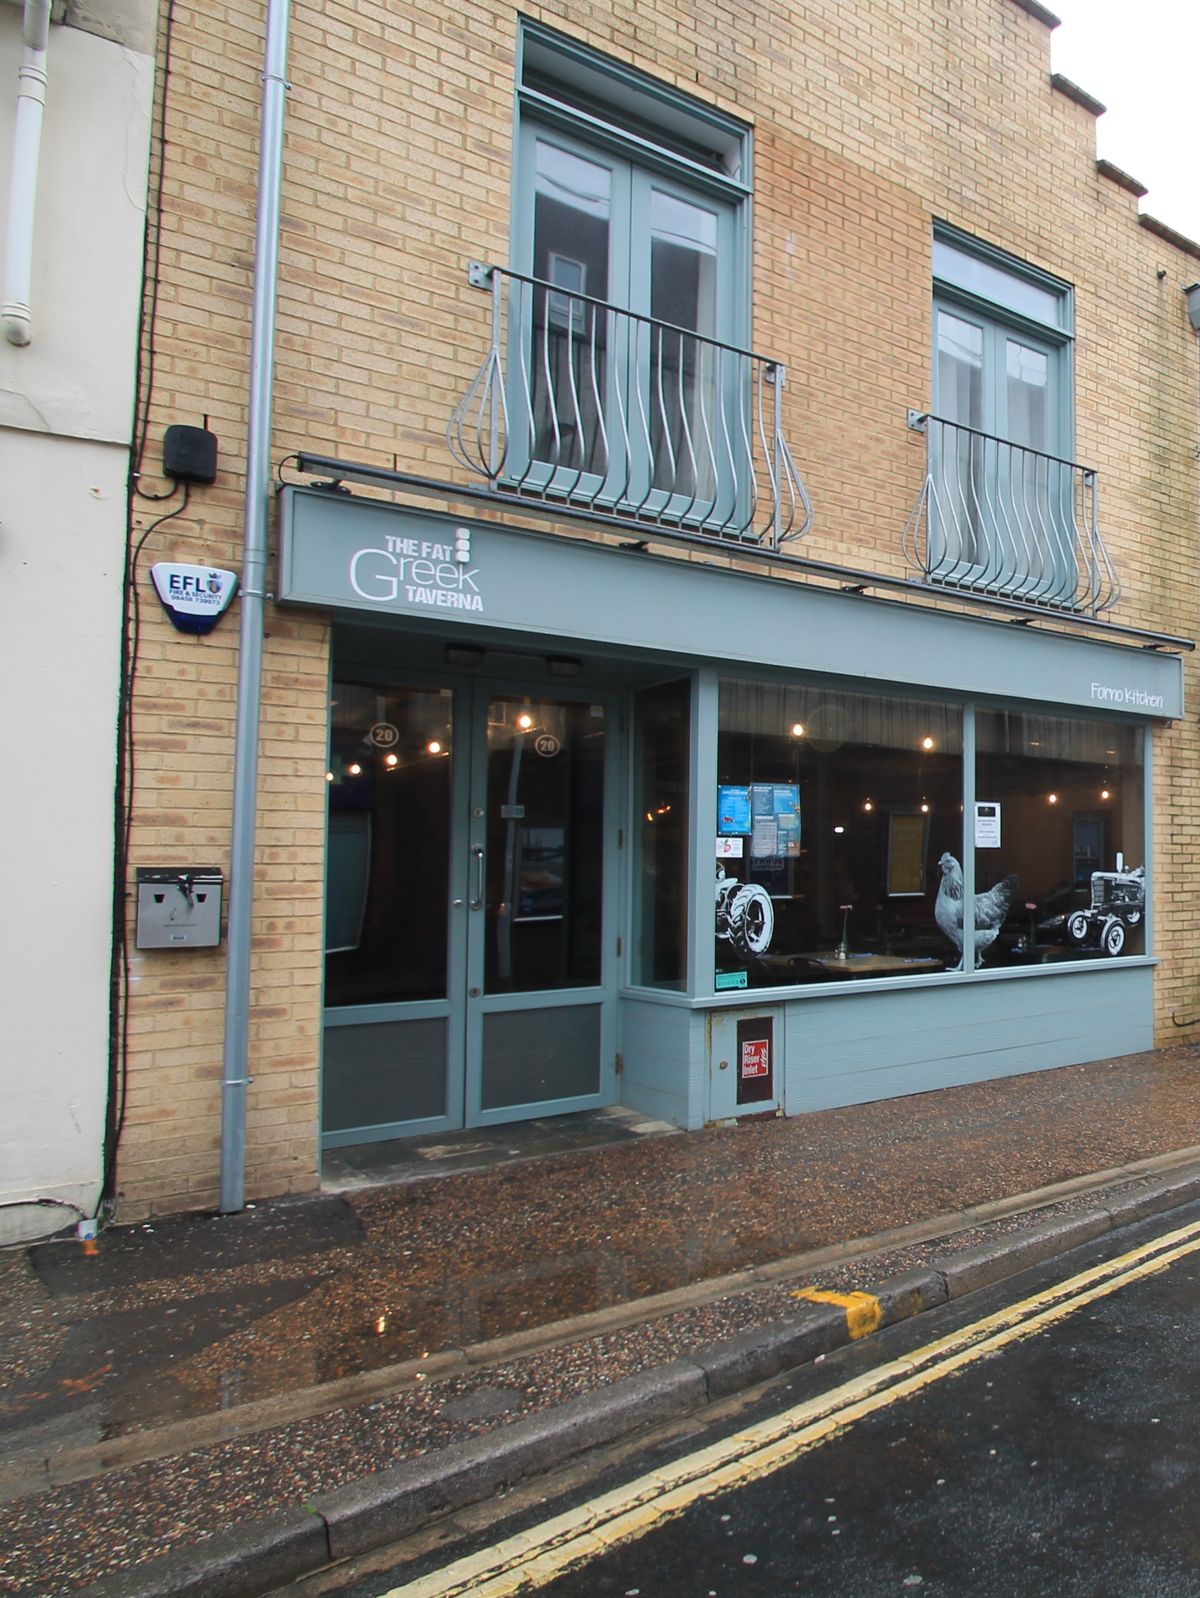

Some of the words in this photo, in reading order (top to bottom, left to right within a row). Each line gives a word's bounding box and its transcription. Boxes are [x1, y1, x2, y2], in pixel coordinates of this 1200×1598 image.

[385, 535, 418, 556] THE
[421, 541, 453, 561] FAT
[350, 548, 480, 601] Greek
[169, 574, 206, 593] EFL
[405, 585, 484, 612] TAVERNA
[1125, 687, 1164, 708] Kitchen
[375, 729, 393, 742] 20
[540, 740, 555, 752] 20
[744, 1044, 755, 1056] Dry
[744, 1055, 760, 1064] Riser
[744, 1064, 758, 1075] Inlet
